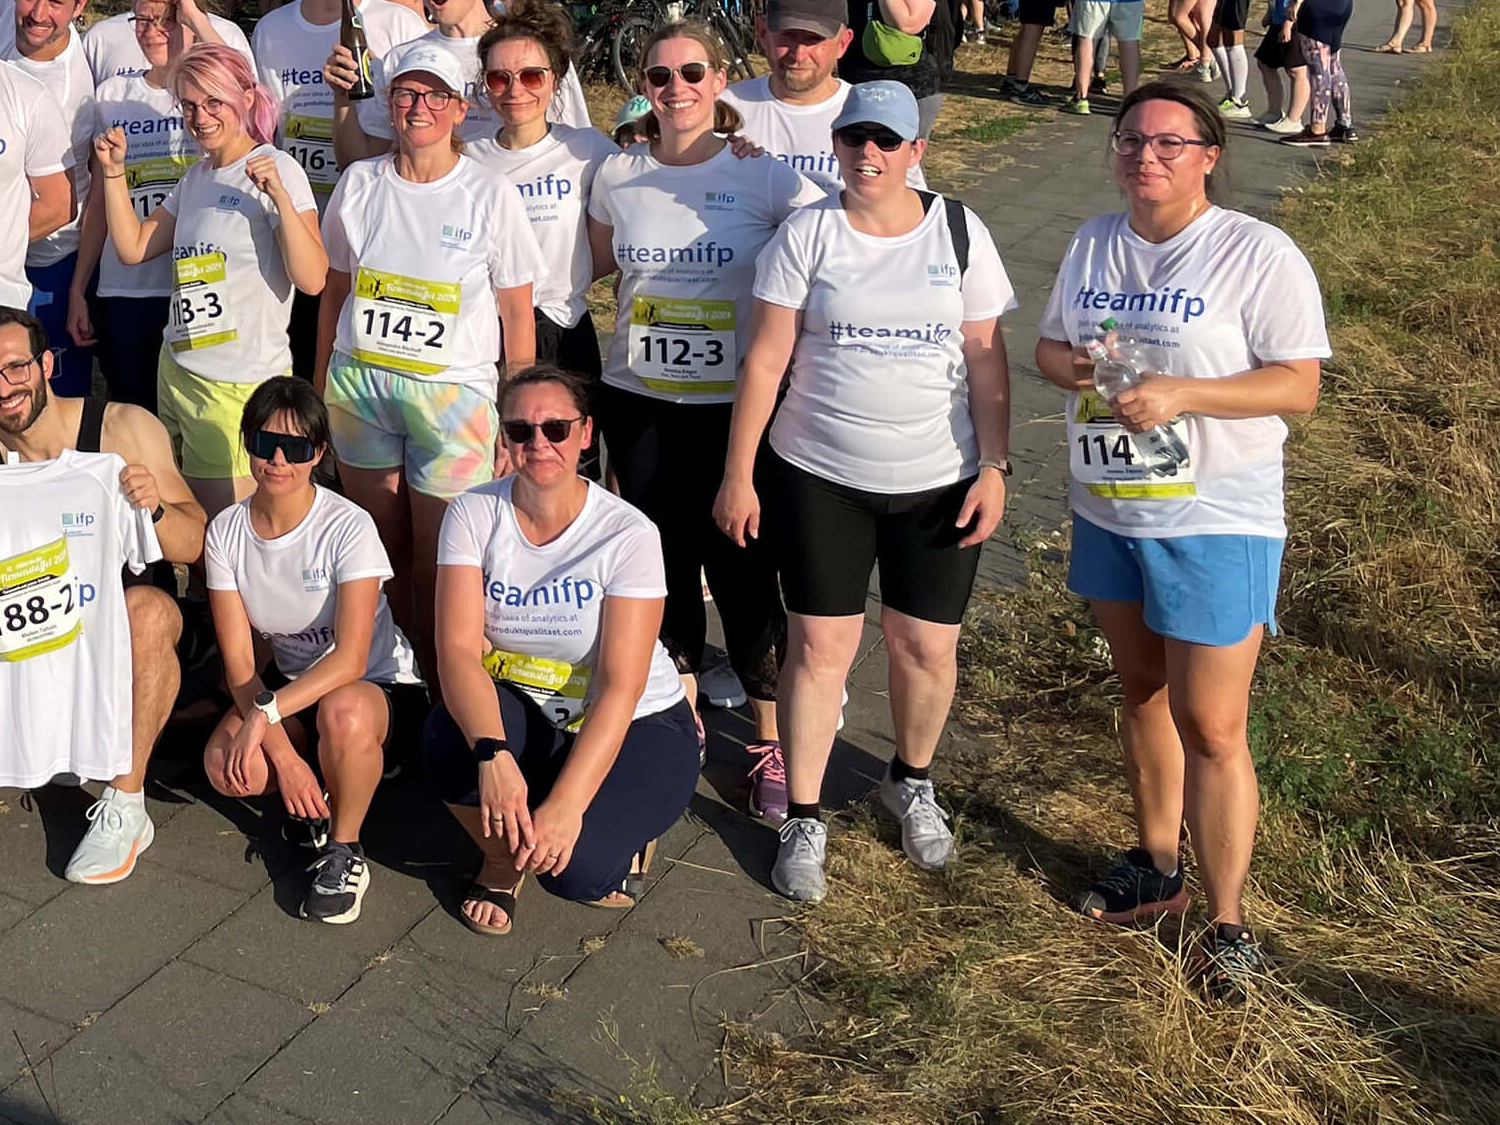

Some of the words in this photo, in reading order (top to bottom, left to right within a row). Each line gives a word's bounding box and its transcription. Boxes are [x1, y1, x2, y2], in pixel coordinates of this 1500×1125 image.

[454, 226, 472, 242] ifp
[617, 242, 734, 268] #teamifp
[940, 263, 956, 277] ifp
[363, 308, 445, 349] 114-2
[640, 335, 724, 366] 112-3
[75, 512, 95, 526] ifp
